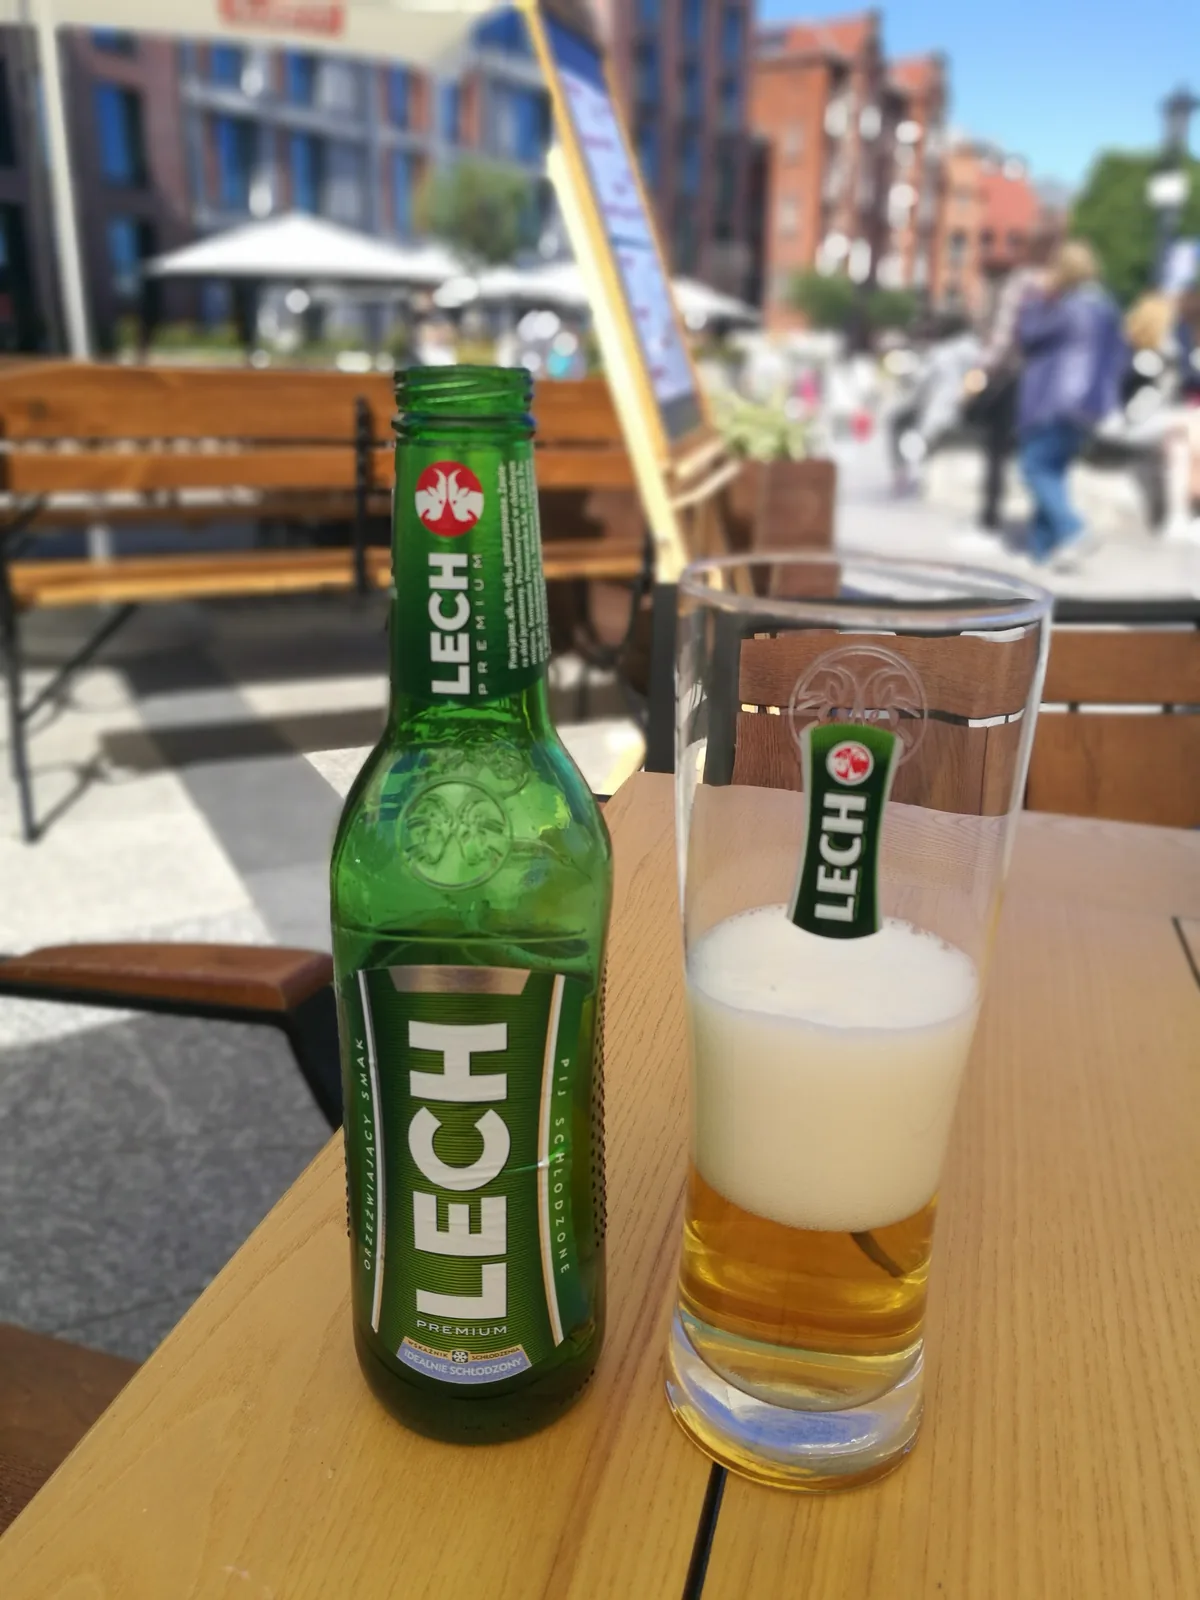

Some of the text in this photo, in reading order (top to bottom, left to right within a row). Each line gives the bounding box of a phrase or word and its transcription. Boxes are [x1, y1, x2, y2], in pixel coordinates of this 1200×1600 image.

[428, 553, 471, 695] LECH
[472, 554, 488, 695] PREMIUM
[814, 792, 868, 922] LECH
[355, 1038, 370, 1101] SMAK
[408, 1020, 511, 1319] LECH
[554, 1058, 570, 1274] PIJ SCHŁODZONE
[404, 1350, 521, 1376] IDEALNIE SCHŁODZONY
[416, 1319, 508, 1336] PREMIUM
[471, 1346, 521, 1360] SCHŁODZENIA
